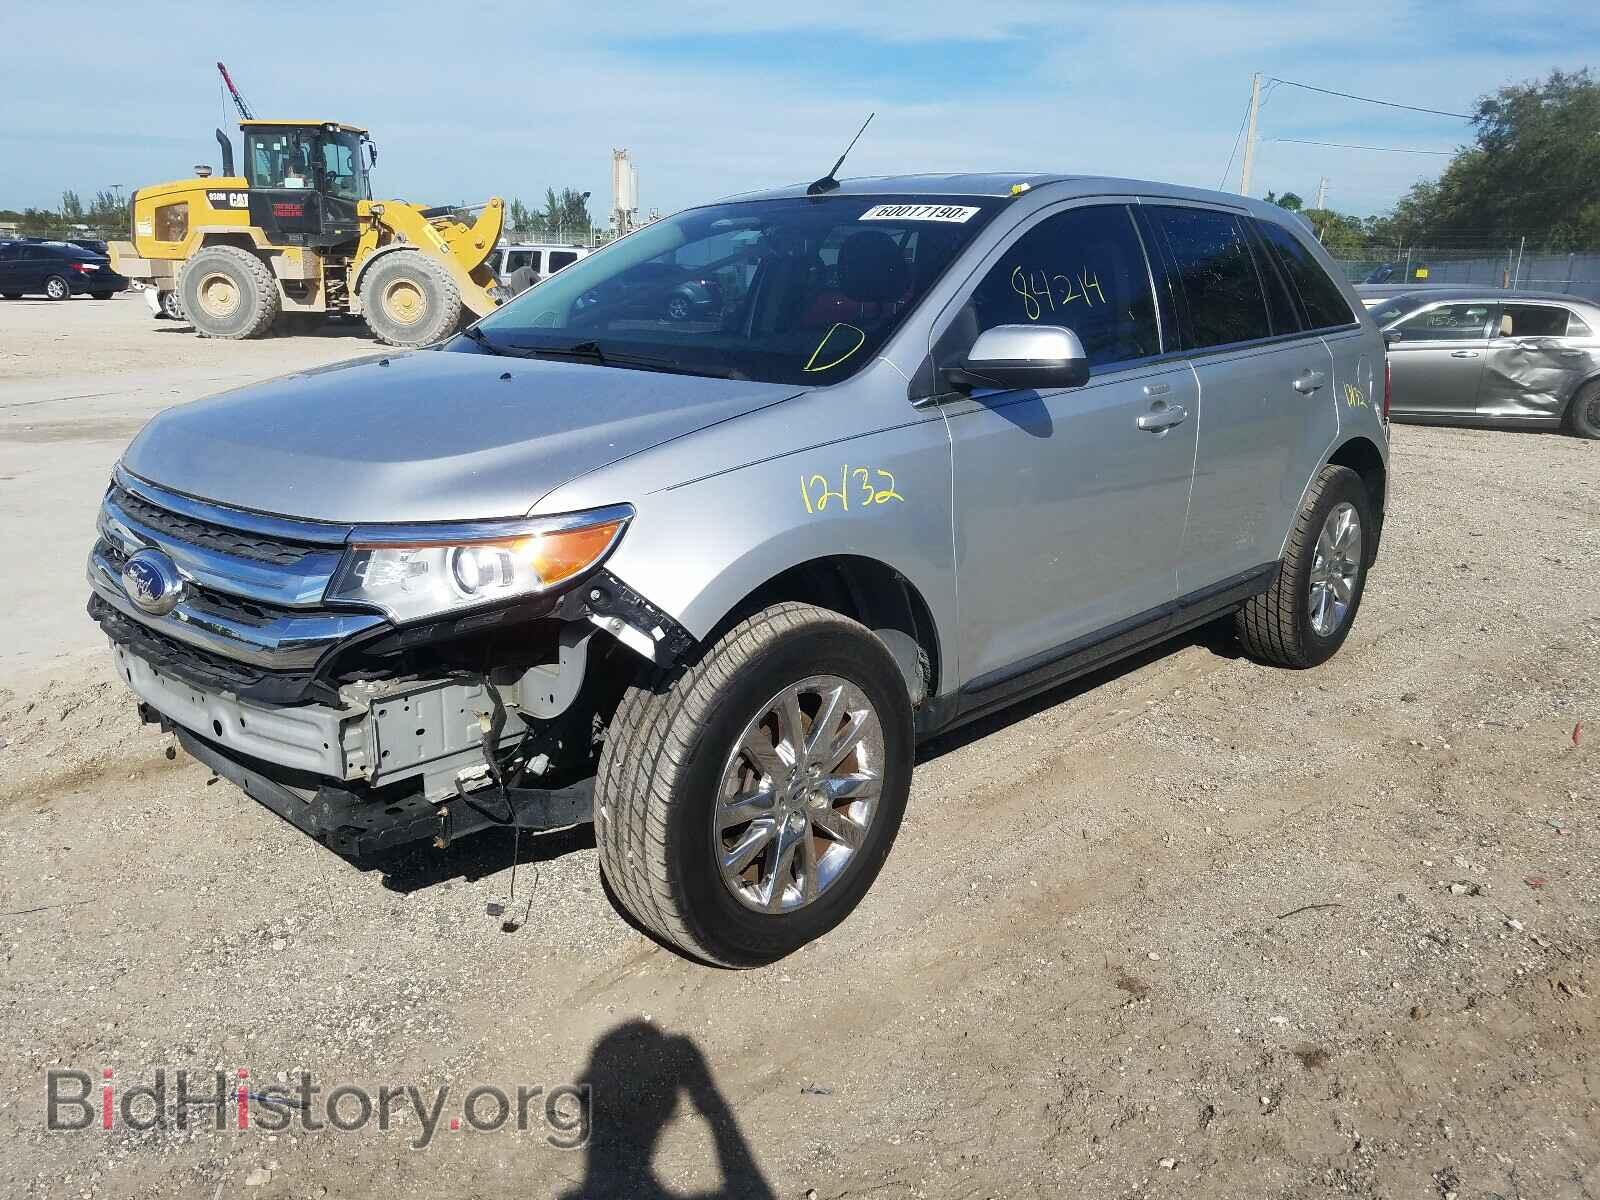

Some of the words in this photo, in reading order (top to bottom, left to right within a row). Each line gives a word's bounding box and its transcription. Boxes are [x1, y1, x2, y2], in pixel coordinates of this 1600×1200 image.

[229, 192, 249, 208] CAT
[800, 322, 865, 372] D
[800, 463, 905, 514] 12/32
